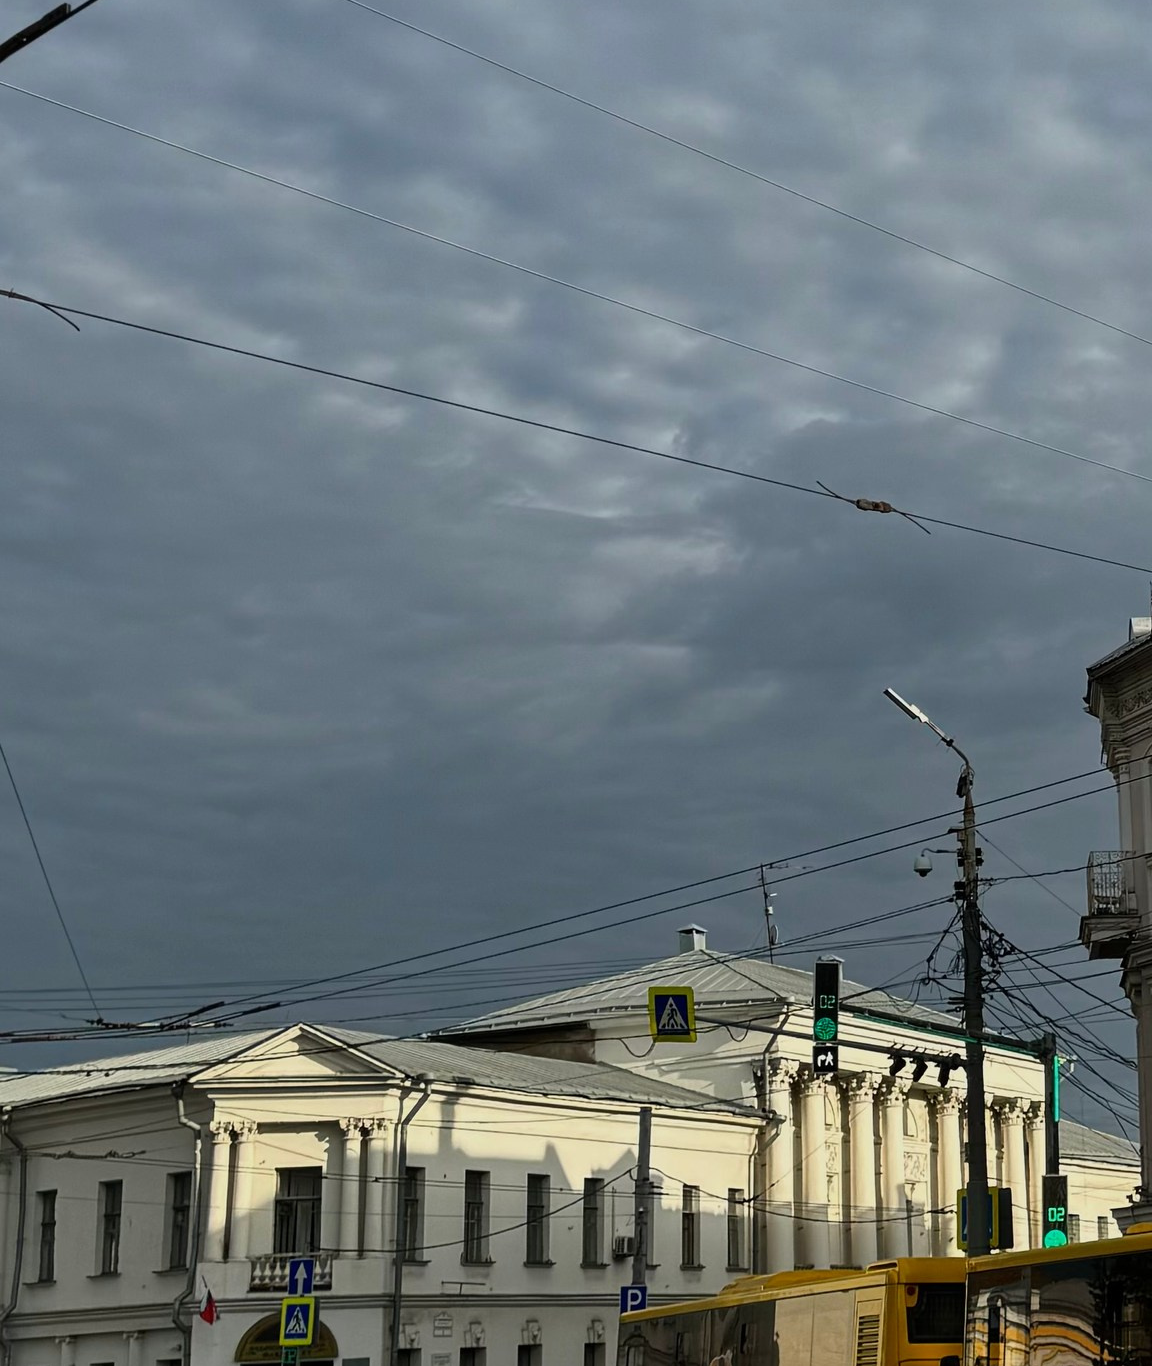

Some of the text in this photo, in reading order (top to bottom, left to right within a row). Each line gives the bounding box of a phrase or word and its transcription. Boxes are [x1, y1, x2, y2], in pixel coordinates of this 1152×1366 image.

[819, 994, 836, 1009] 02
[1047, 1206, 1065, 1222] 02
[627, 1288, 642, 1313] P
